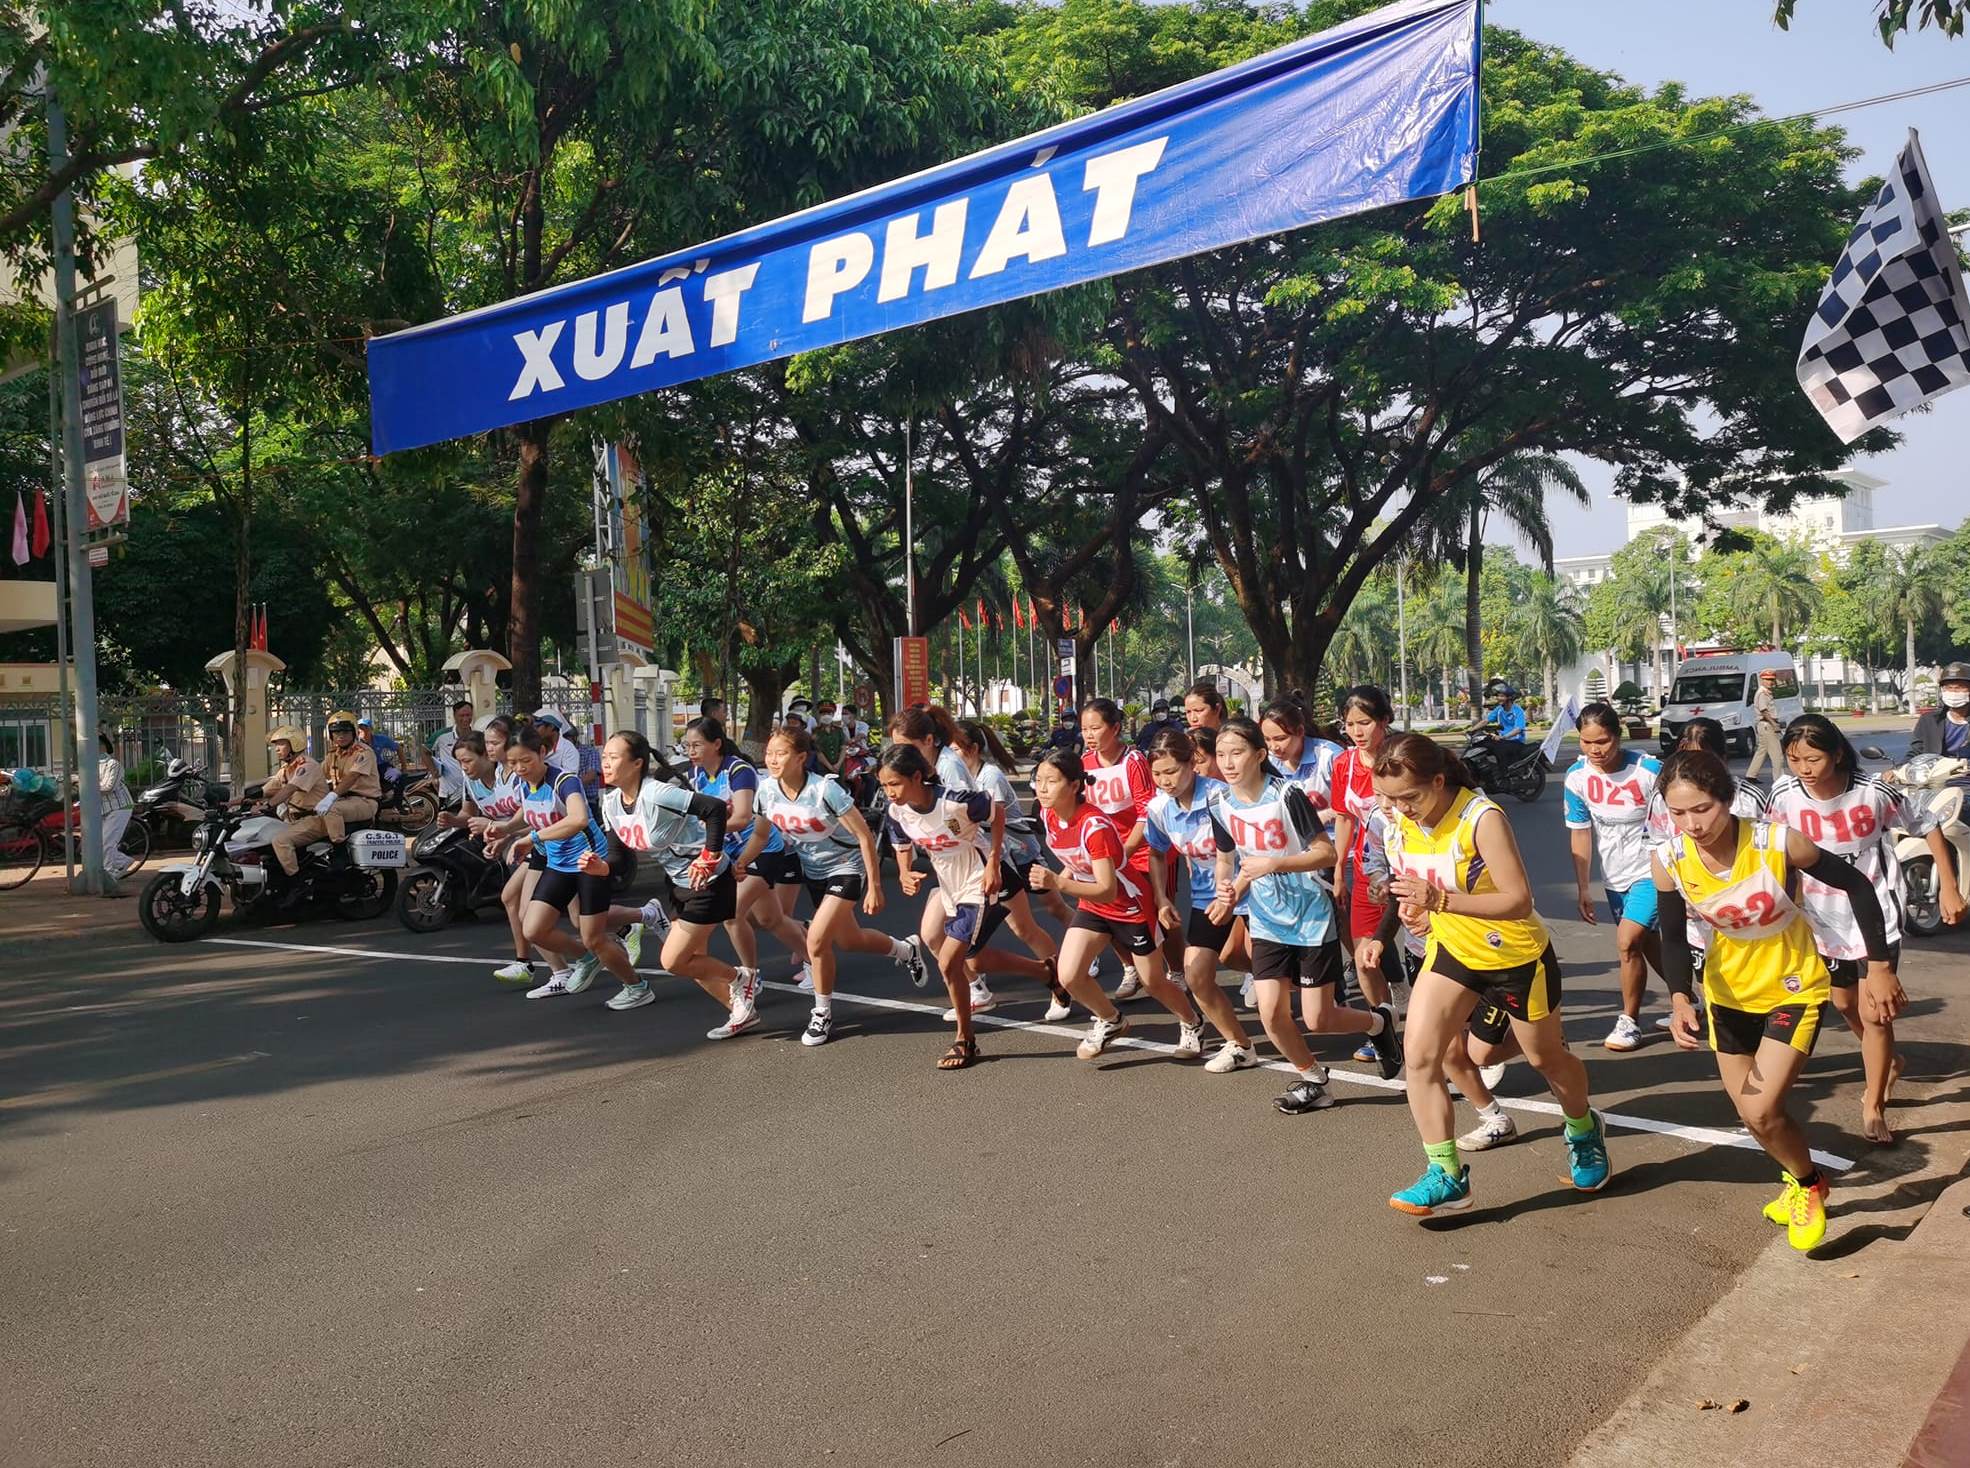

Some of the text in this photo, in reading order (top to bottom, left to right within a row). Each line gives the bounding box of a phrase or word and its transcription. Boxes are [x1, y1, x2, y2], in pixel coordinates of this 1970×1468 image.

[508, 136, 1169, 402] XUẤT PHÁT
[1587, 774, 1646, 807] 021
[1230, 814, 1289, 852] 013
[1800, 803, 1876, 843] 018
[371, 850, 399, 860] POLICE
